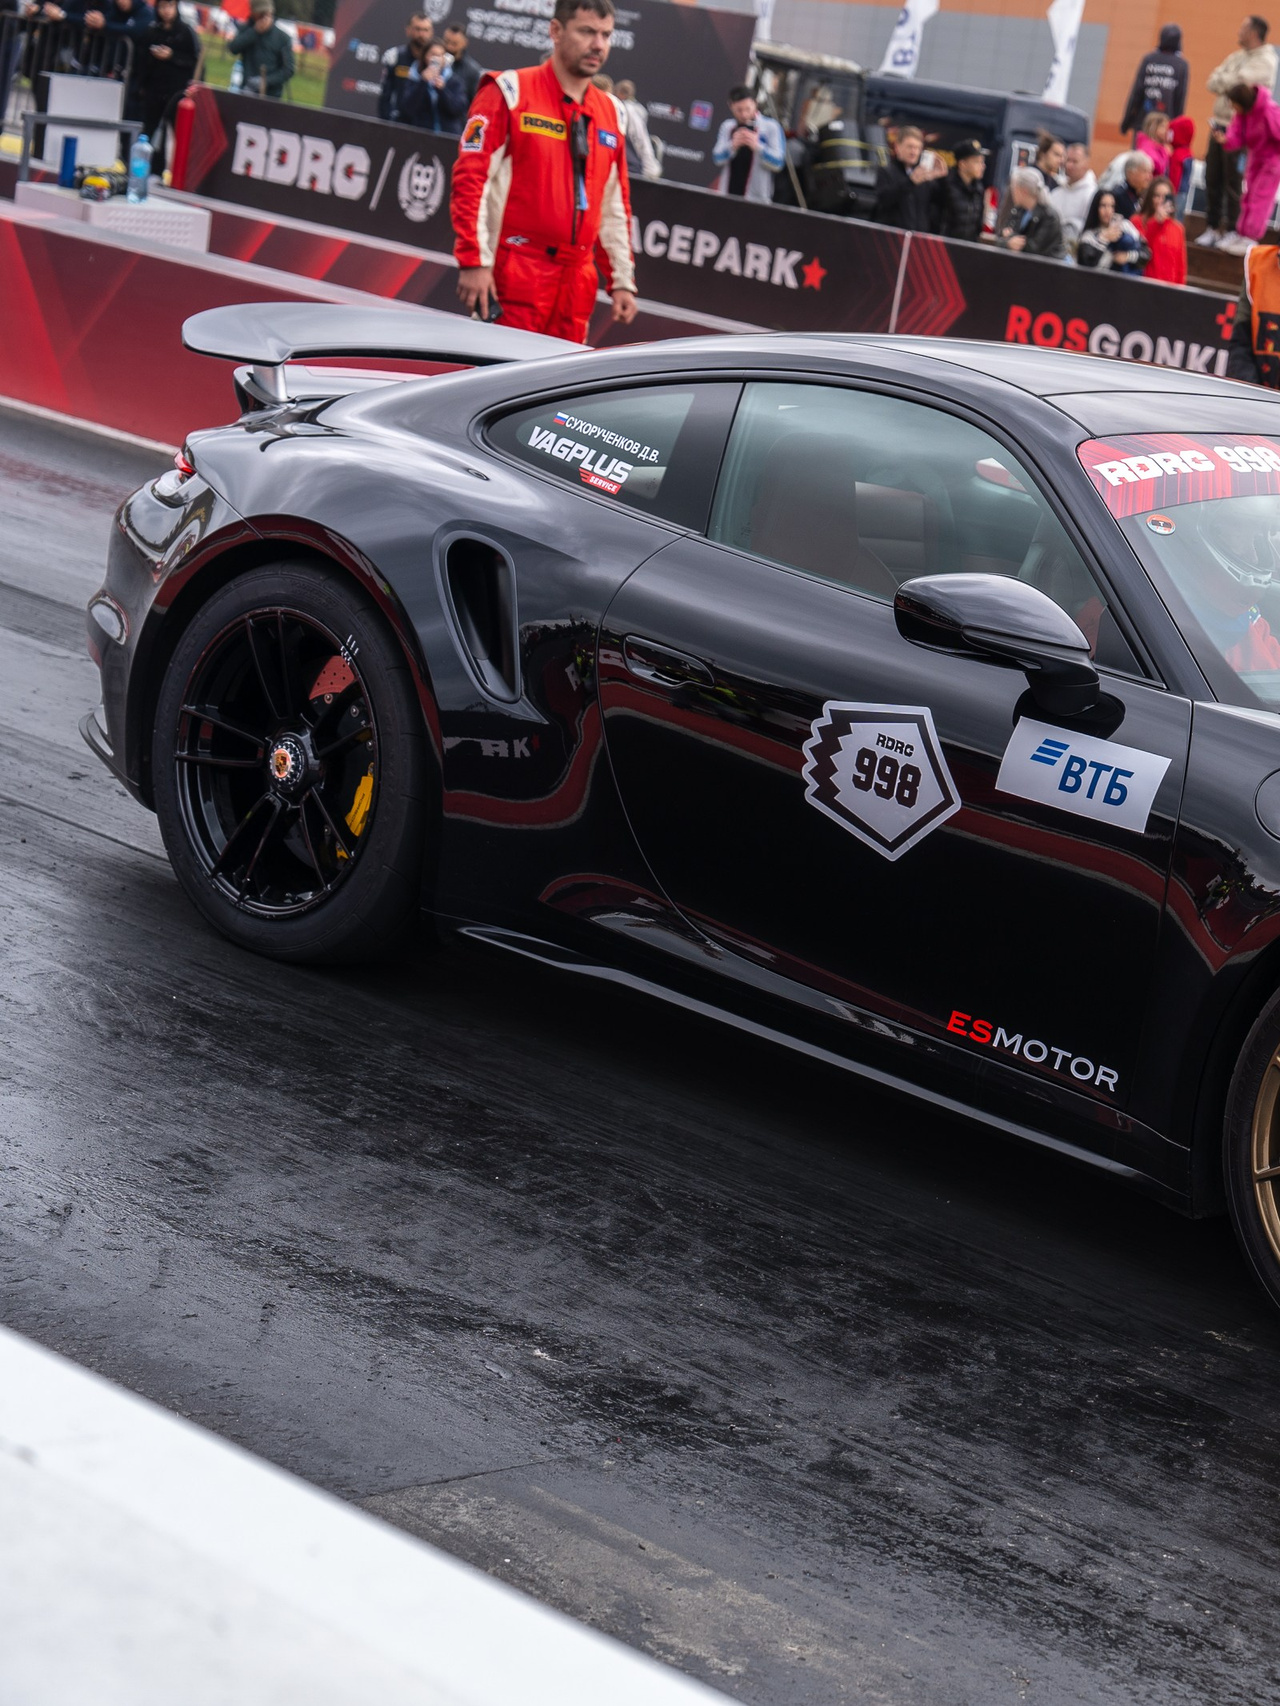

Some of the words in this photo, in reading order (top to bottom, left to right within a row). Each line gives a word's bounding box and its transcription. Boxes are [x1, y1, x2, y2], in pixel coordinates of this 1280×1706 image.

[231, 121, 372, 201] RDRC
[1005, 304, 1230, 377] ROSGONKI
[527, 426, 634, 484] VAGPLUS
[565, 416, 641, 455] СУХОРУЧЕНКОВ
[637, 446, 660, 464] Д.В.
[589, 475, 618, 493] SERVICE
[1092, 450, 1216, 487] RDRC
[876, 733, 915, 758] RDRC
[851, 746, 922, 809] 998
[1057, 755, 1135, 807] ВТБ
[946, 1010, 1120, 1093] ESMOTOR
